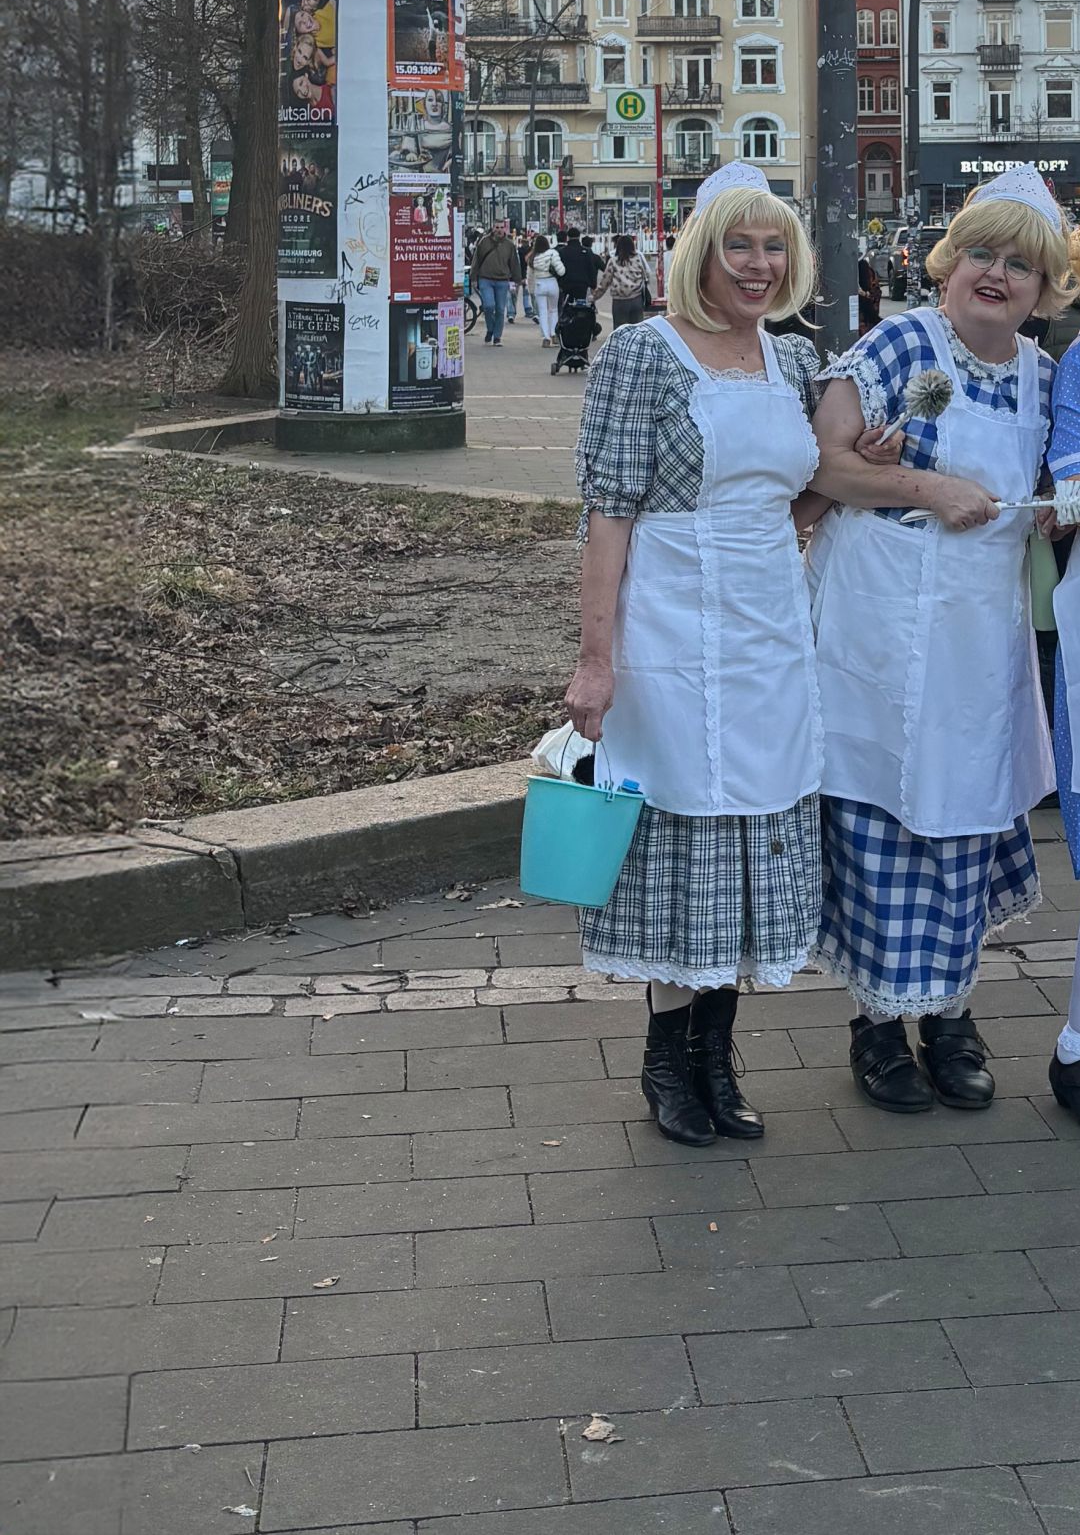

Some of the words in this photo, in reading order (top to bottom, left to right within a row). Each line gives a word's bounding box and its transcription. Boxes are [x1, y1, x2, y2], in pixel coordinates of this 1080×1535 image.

[393, 252, 418, 262] JAHR
[287, 320, 305, 330] BEE
[307, 321, 340, 332] GEES
